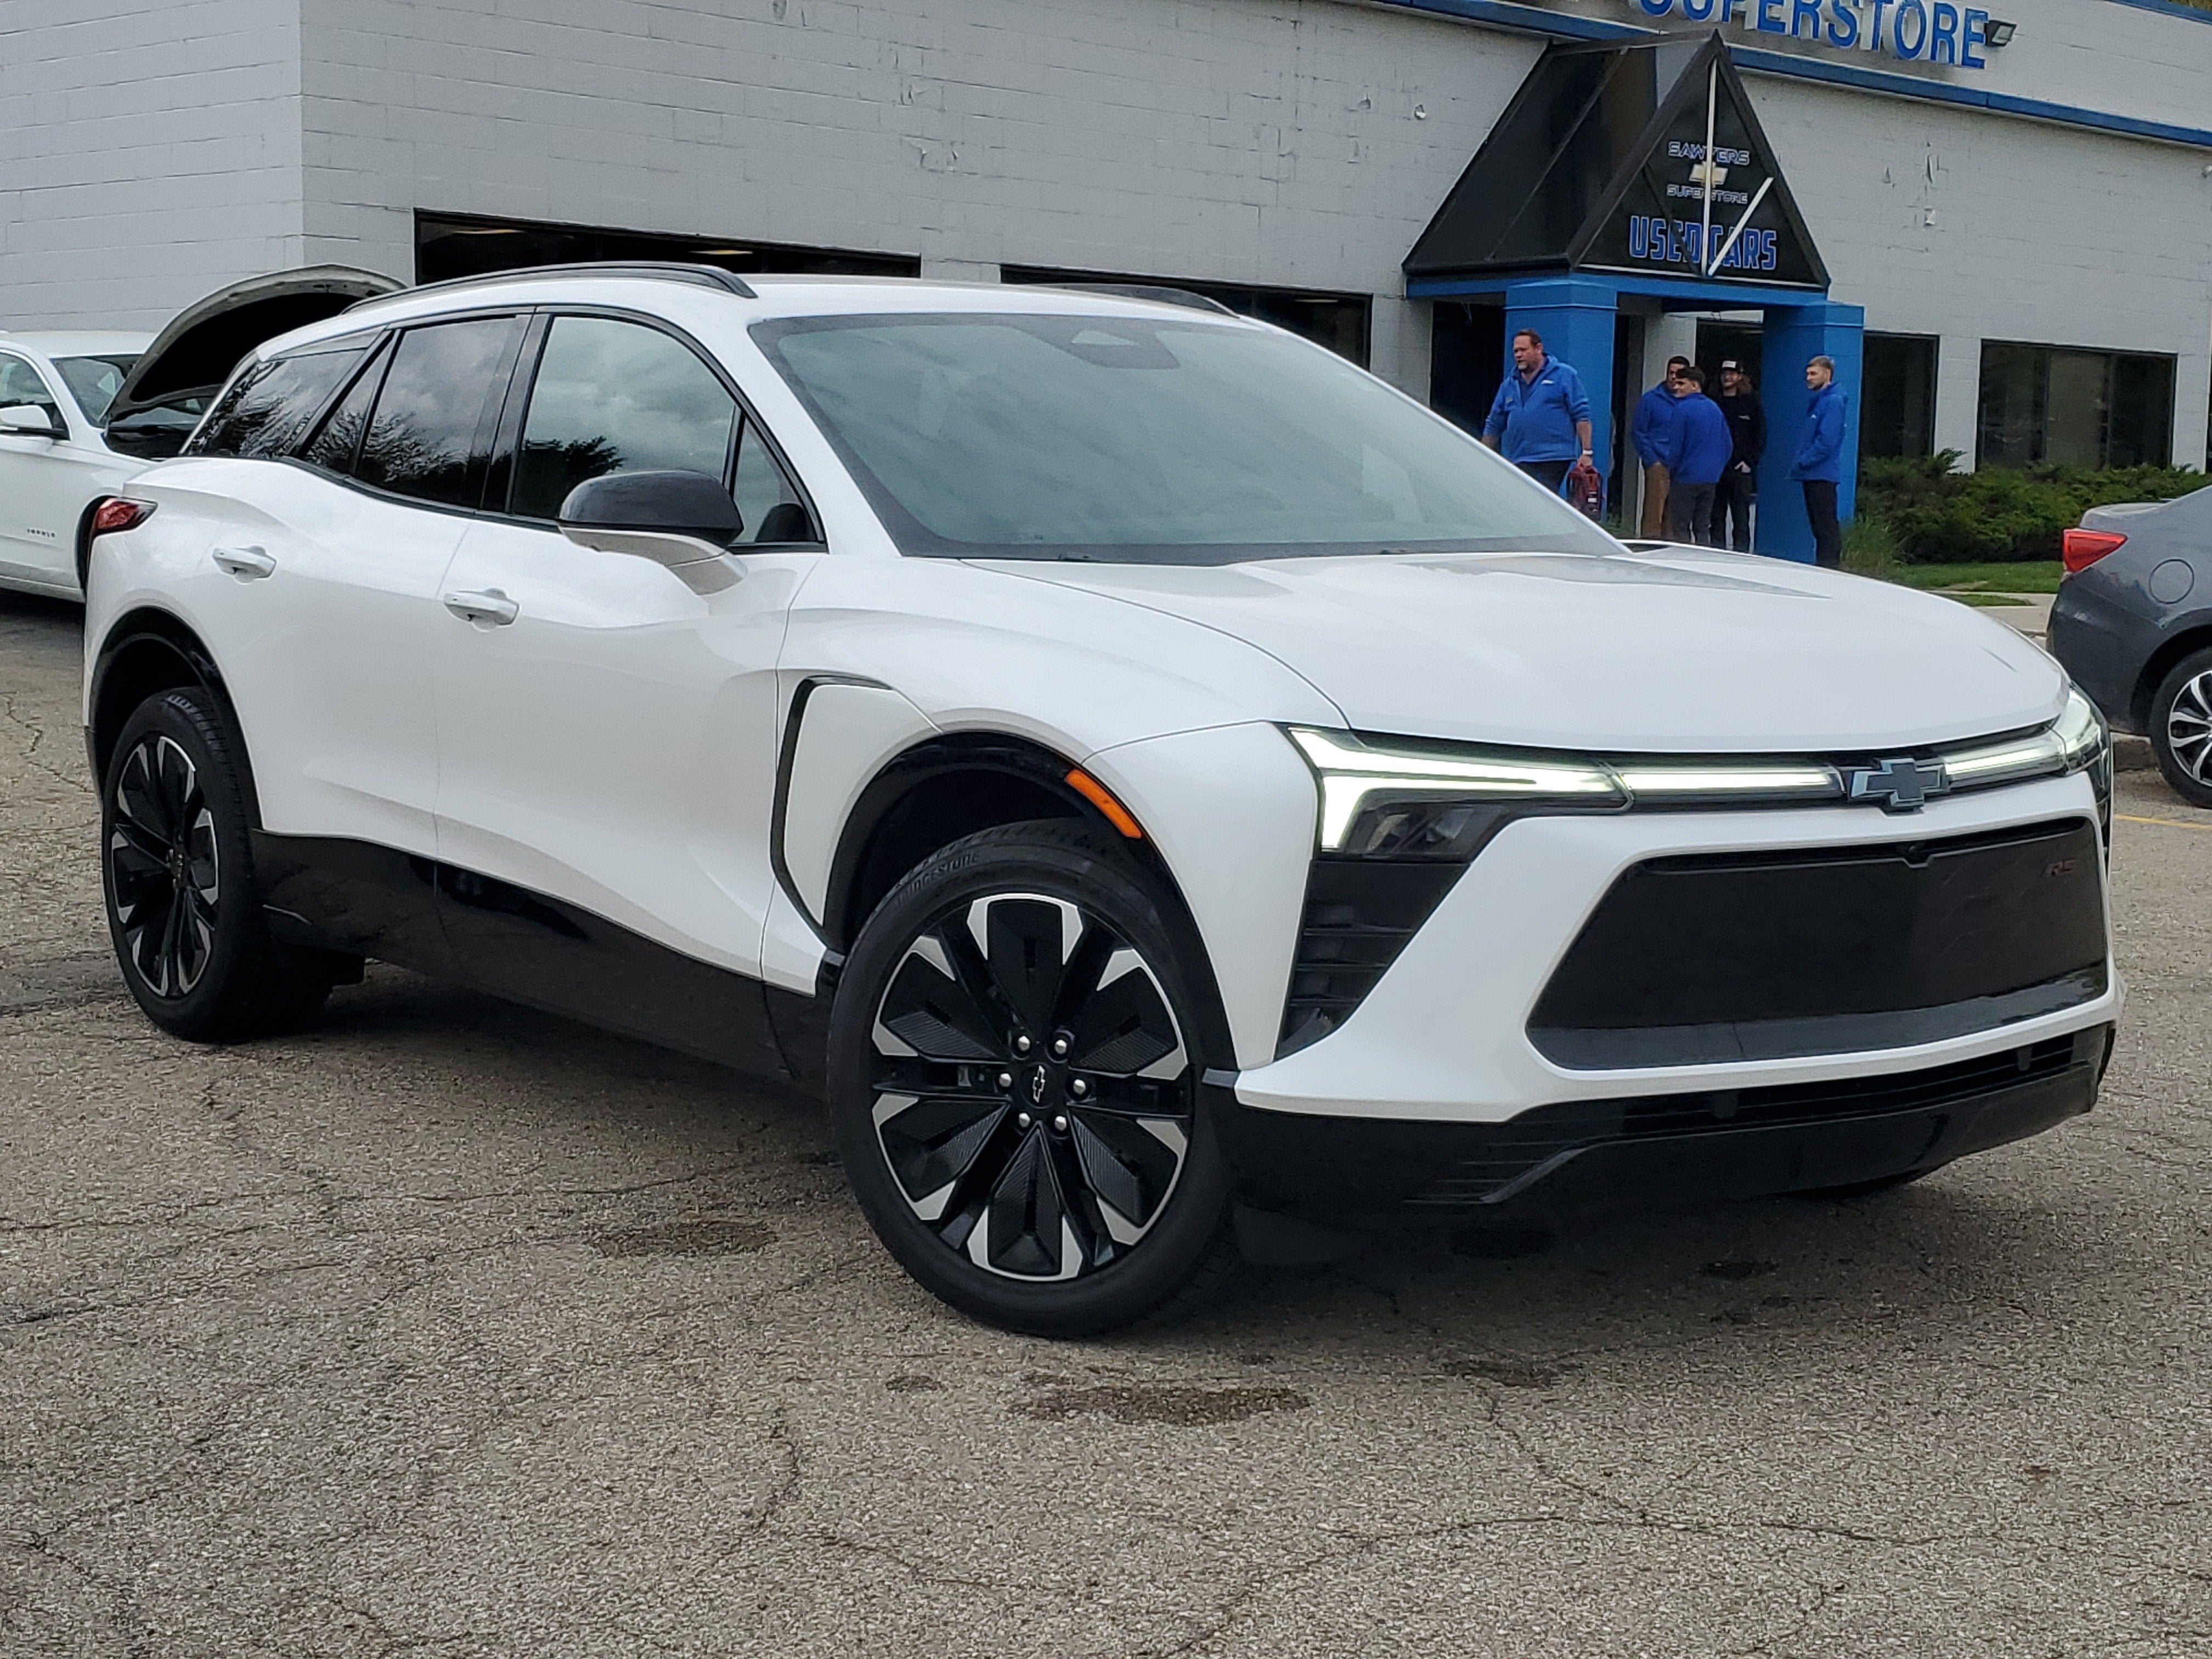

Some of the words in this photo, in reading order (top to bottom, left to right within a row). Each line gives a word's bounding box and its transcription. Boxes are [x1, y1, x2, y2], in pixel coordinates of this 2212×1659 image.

[1639, 0, 1988, 69] ERSTORE
[1629, 215, 1702, 263] USED
[1708, 224, 1777, 270] CARS
